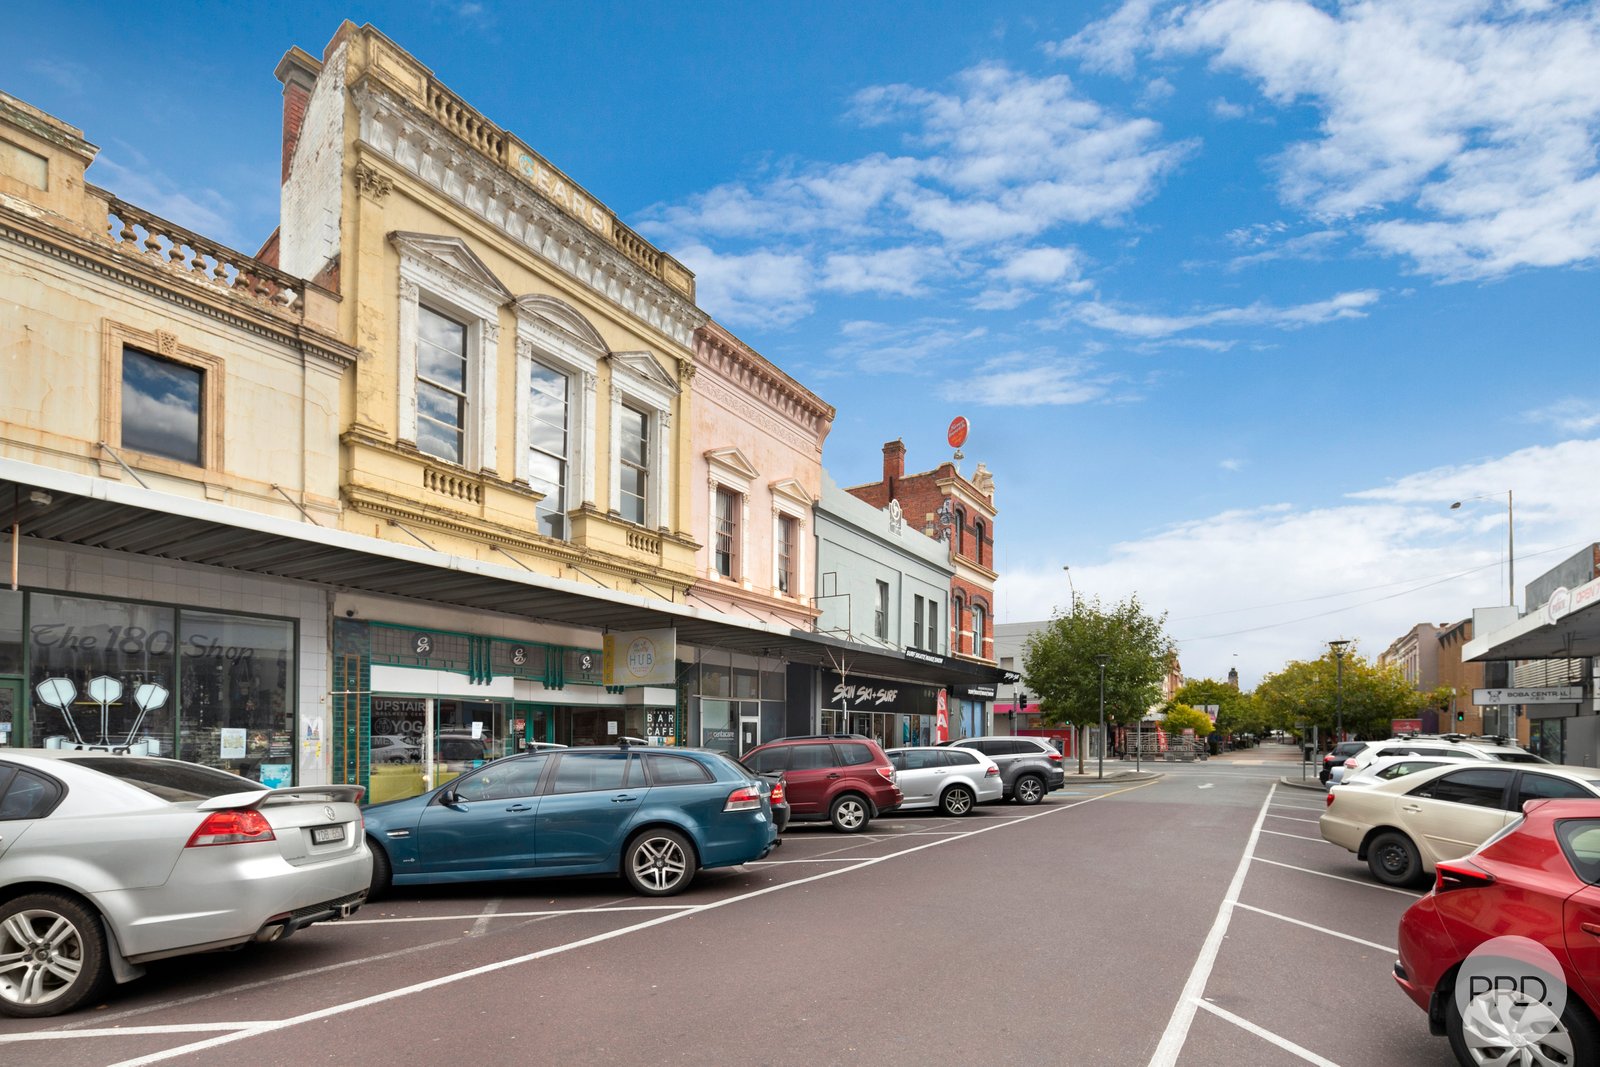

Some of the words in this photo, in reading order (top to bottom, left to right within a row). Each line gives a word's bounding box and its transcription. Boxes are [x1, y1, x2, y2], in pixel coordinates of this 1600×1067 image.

[518, 153, 605, 231] GEARS
[31, 623, 97, 651] The
[104, 625, 173, 656] 180
[186, 634, 255, 663] Shop
[629, 653, 653, 666] HUB
[647, 713, 674, 723] BAR
[647, 727, 674, 736] CAFE
